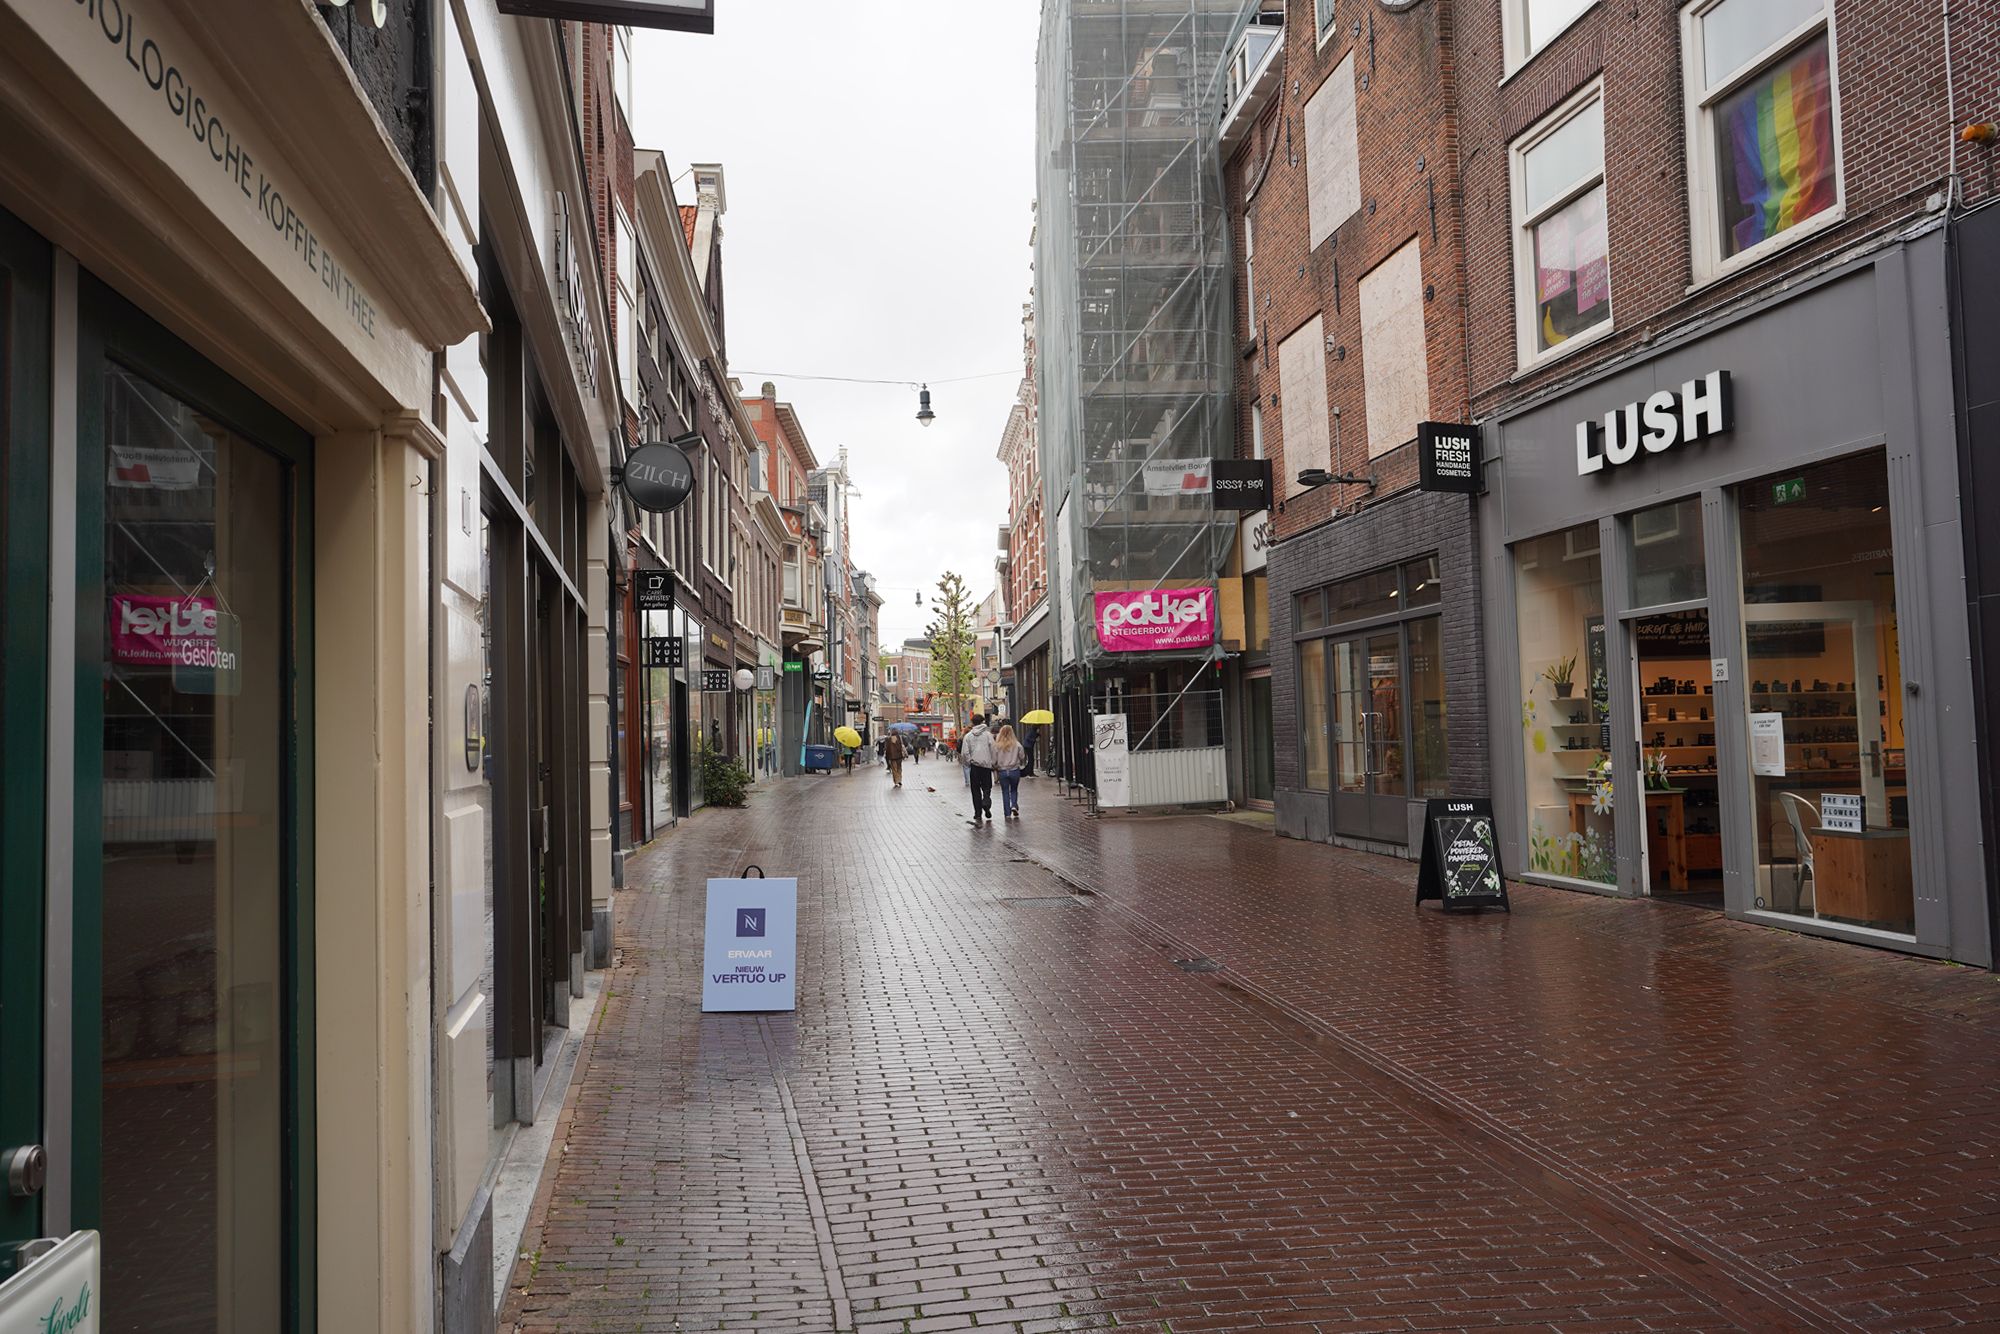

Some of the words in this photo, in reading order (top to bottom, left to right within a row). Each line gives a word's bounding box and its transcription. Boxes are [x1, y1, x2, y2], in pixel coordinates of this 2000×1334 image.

[75, 0, 252, 198] OLOGISCHE
[259, 173, 318, 273] KOFFIE
[321, 250, 341, 300] EN
[344, 276, 376, 340] THEE
[1576, 370, 1726, 476] LUSH
[1435, 436, 1470, 450] LUSH
[1435, 449, 1471, 462] FRESH
[1188, 462, 1209, 470] Bouw
[1436, 461, 1471, 470] HANDMADE
[628, 461, 688, 490] ZILCH
[1436, 469, 1471, 477] COSMETICS
[1103, 593, 1207, 635] patkel
[1112, 626, 1175, 636] STEIGERBOUW
[1155, 634, 1210, 645] www.patkel.nl
[183, 640, 236, 670] Gesloten
[1716, 668, 1725, 677] 29
[1448, 803, 1474, 811] LUSH
[1823, 808, 1858, 817] FLOWERS
[1450, 846, 1484, 855] POWERED
[1447, 853, 1489, 862] PAMPERING
[728, 950, 772, 959] ERVAAR
[712, 974, 766, 984] VERTUO
[768, 974, 786, 983] UP
